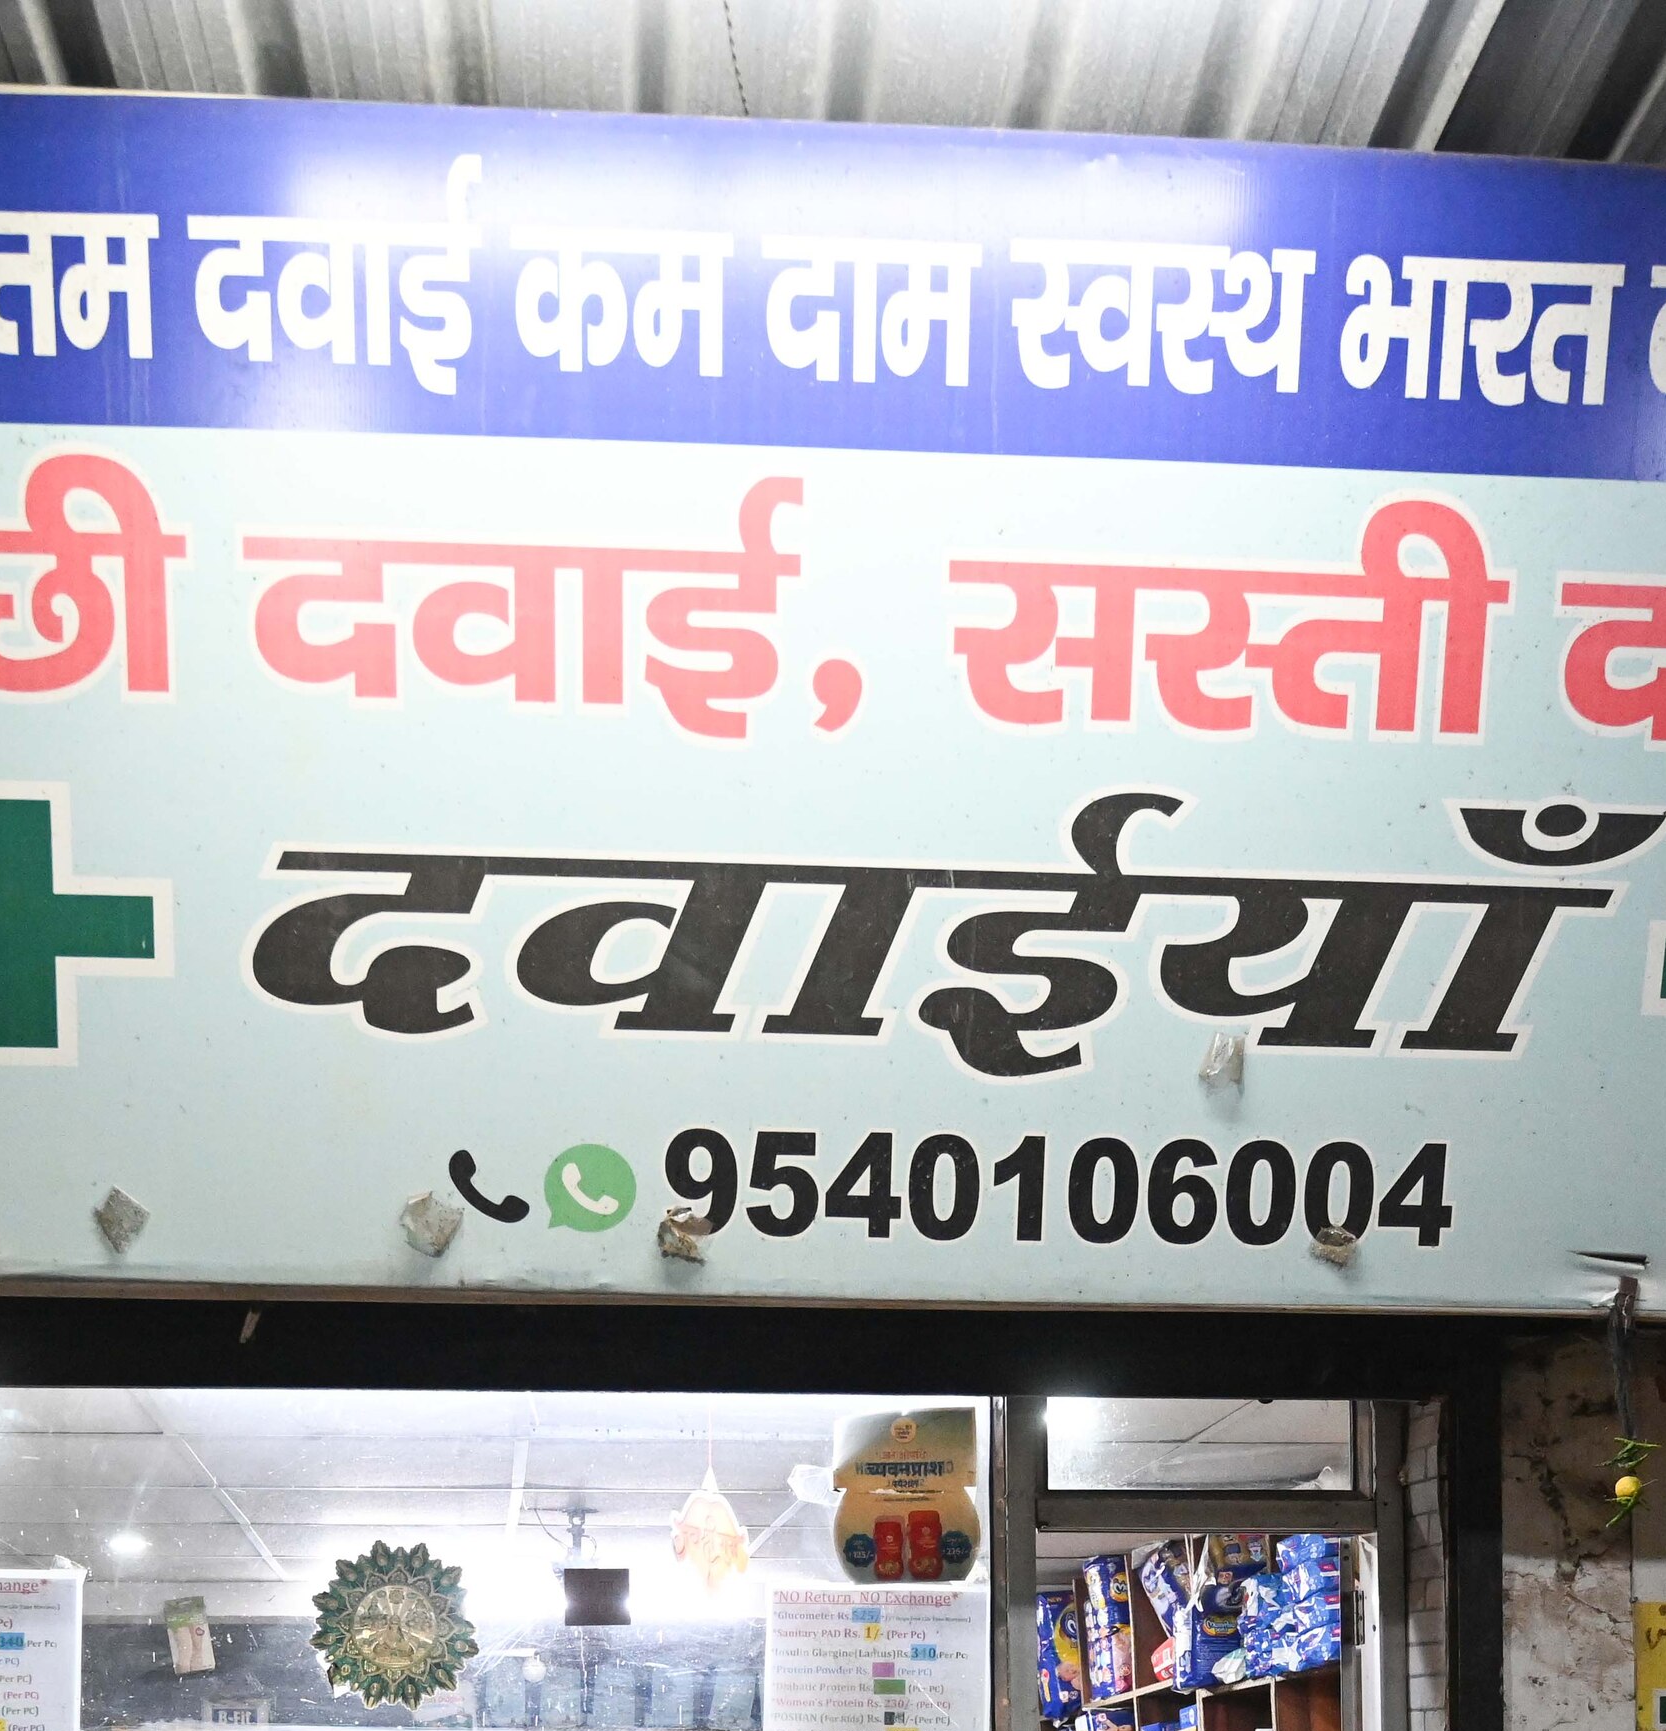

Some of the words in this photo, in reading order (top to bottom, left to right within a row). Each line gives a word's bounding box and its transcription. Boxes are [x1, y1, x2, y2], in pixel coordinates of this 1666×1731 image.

[187, 154, 482, 395] दवाई
[510, 225, 732, 378] कम
[760, 235, 982, 387] दाम
[1009, 238, 1315, 394] स्वस्थ
[1340, 253, 1624, 406] भारत
[244, 476, 863, 738] दवाई,
[948, 500, 1510, 736] सस्ती
[252, 793, 1665, 1078] दवाईयाँ
[664, 1127, 1454, 1247] 9540106004
[860, 1592, 880, 1602] NO
